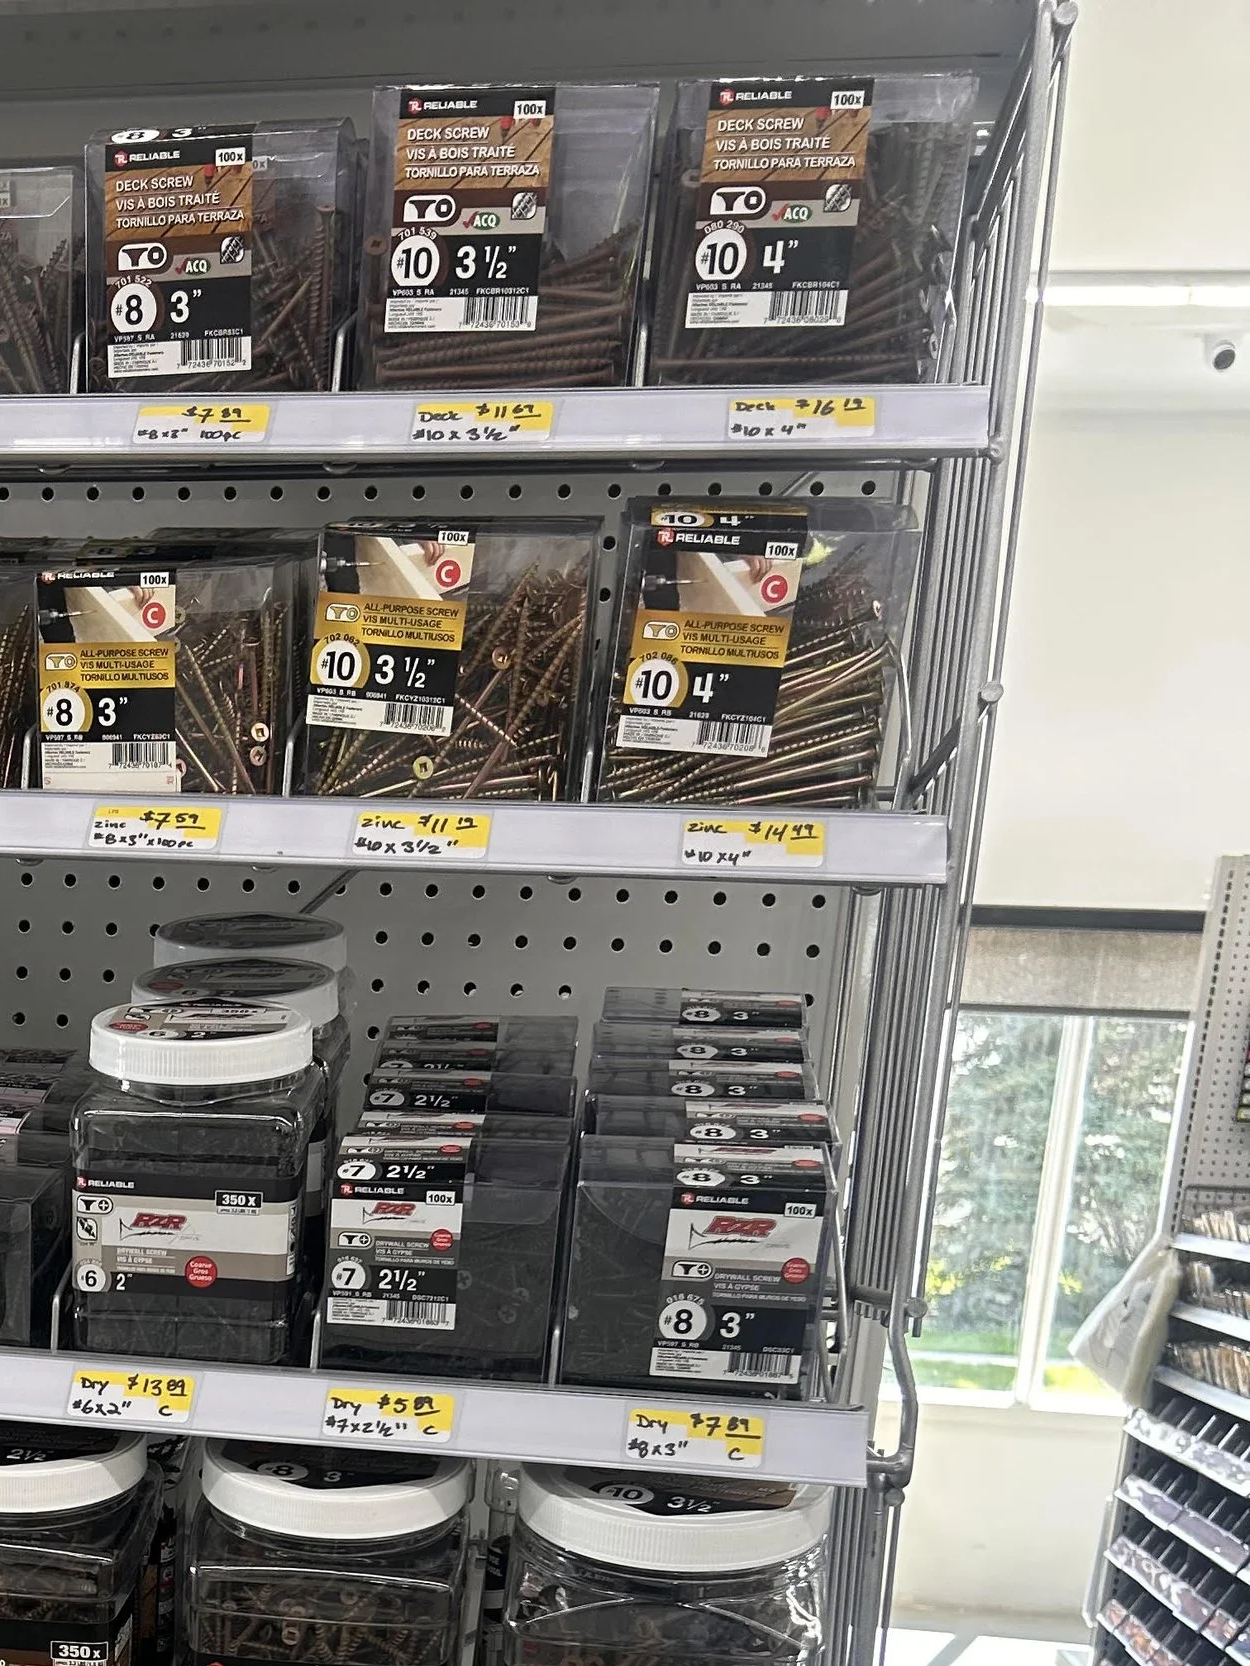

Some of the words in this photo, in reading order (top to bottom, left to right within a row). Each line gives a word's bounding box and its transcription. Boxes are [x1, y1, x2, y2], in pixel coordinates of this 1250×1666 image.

[734, 91, 793, 102] RELIABLE
[833, 93, 863, 106] 100x
[423, 100, 479, 111] RELIABLE
[516, 103, 544, 115] 100x
[716, 119, 754, 132] DECK
[756, 117, 805, 131] SCREW
[406, 127, 442, 141] DECK
[444, 126, 490, 140] SCREW
[715, 139, 739, 152] VIS
[749, 137, 782, 151] BOIS
[783, 135, 832, 149] TRAITÉ
[129, 151, 181, 162] RELIABLE
[218, 151, 244, 163] 100x
[405, 147, 428, 161] VIS
[439, 147, 469, 160] BOIS
[470, 145, 516, 159] TRAITÉ
[713, 158, 770, 171] TORNILLO
[770, 157, 802, 169] PARA
[802, 155, 857, 168] TERRAZA
[405, 166, 458, 180] TORNILLO
[459, 165, 489, 178] PARA
[489, 163, 541, 177] TERRAZA
[115, 179, 149, 191] DECK
[150, 176, 194, 189] SCREW
[115, 199, 136, 211] VIS
[147, 195, 176, 208] BOIS
[177, 191, 220, 206] TRAITÉ
[116, 216, 166, 229] TORNILLO
[166, 213, 196, 225] PARA
[196, 210, 245, 223] TERRAZA
[782, 206, 809, 221] ACQ
[472, 213, 497, 229] ACQ
[185, 260, 208, 274] ACQ
[417, 411, 463, 422] Deck
[440, 531, 467, 543] 100x
[674, 532, 740, 546] RELIABLE
[767, 545, 795, 557] 100x
[141, 575, 167, 586] 100x
[363, 602, 425, 616] ALL-PURPOSE
[425, 606, 460, 618] SCREW
[363, 615, 378, 625] VIS
[378, 615, 443, 629] MULTI-USAGE
[683, 619, 748, 633] ALL-PURPOSE
[748, 622, 784, 635] SCREW
[361, 627, 405, 639] TORNILLO
[404, 629, 456, 643] MULTIUSOS
[681, 631, 699, 642] VIS
[699, 633, 766, 647] MULTI-USAGE
[79, 648, 136, 659] ALL-PURPOSE
[136, 647, 169, 658] SCREW
[679, 645, 726, 658] TORNILLO
[725, 647, 779, 661] MULTIUSOS
[80, 659, 95, 669] VIS
[95, 659, 155, 669] MULTI-USAGE
[80, 671, 121, 682] TORNILLO
[121, 671, 170, 682] MULTIUSOS
[88, 1180, 135, 1190] RELIABLE
[354, 1186, 405, 1196] RELIABLE
[428, 1194, 453, 1205] 100x
[694, 1195, 749, 1205] RELIABLE
[786, 1205, 813, 1217] 100x
[751, 1274, 780, 1284] SCREW
[79, 1377, 110, 1396] Dry
[331, 1397, 362, 1416] Dry
[636, 1414, 669, 1434] Dry
